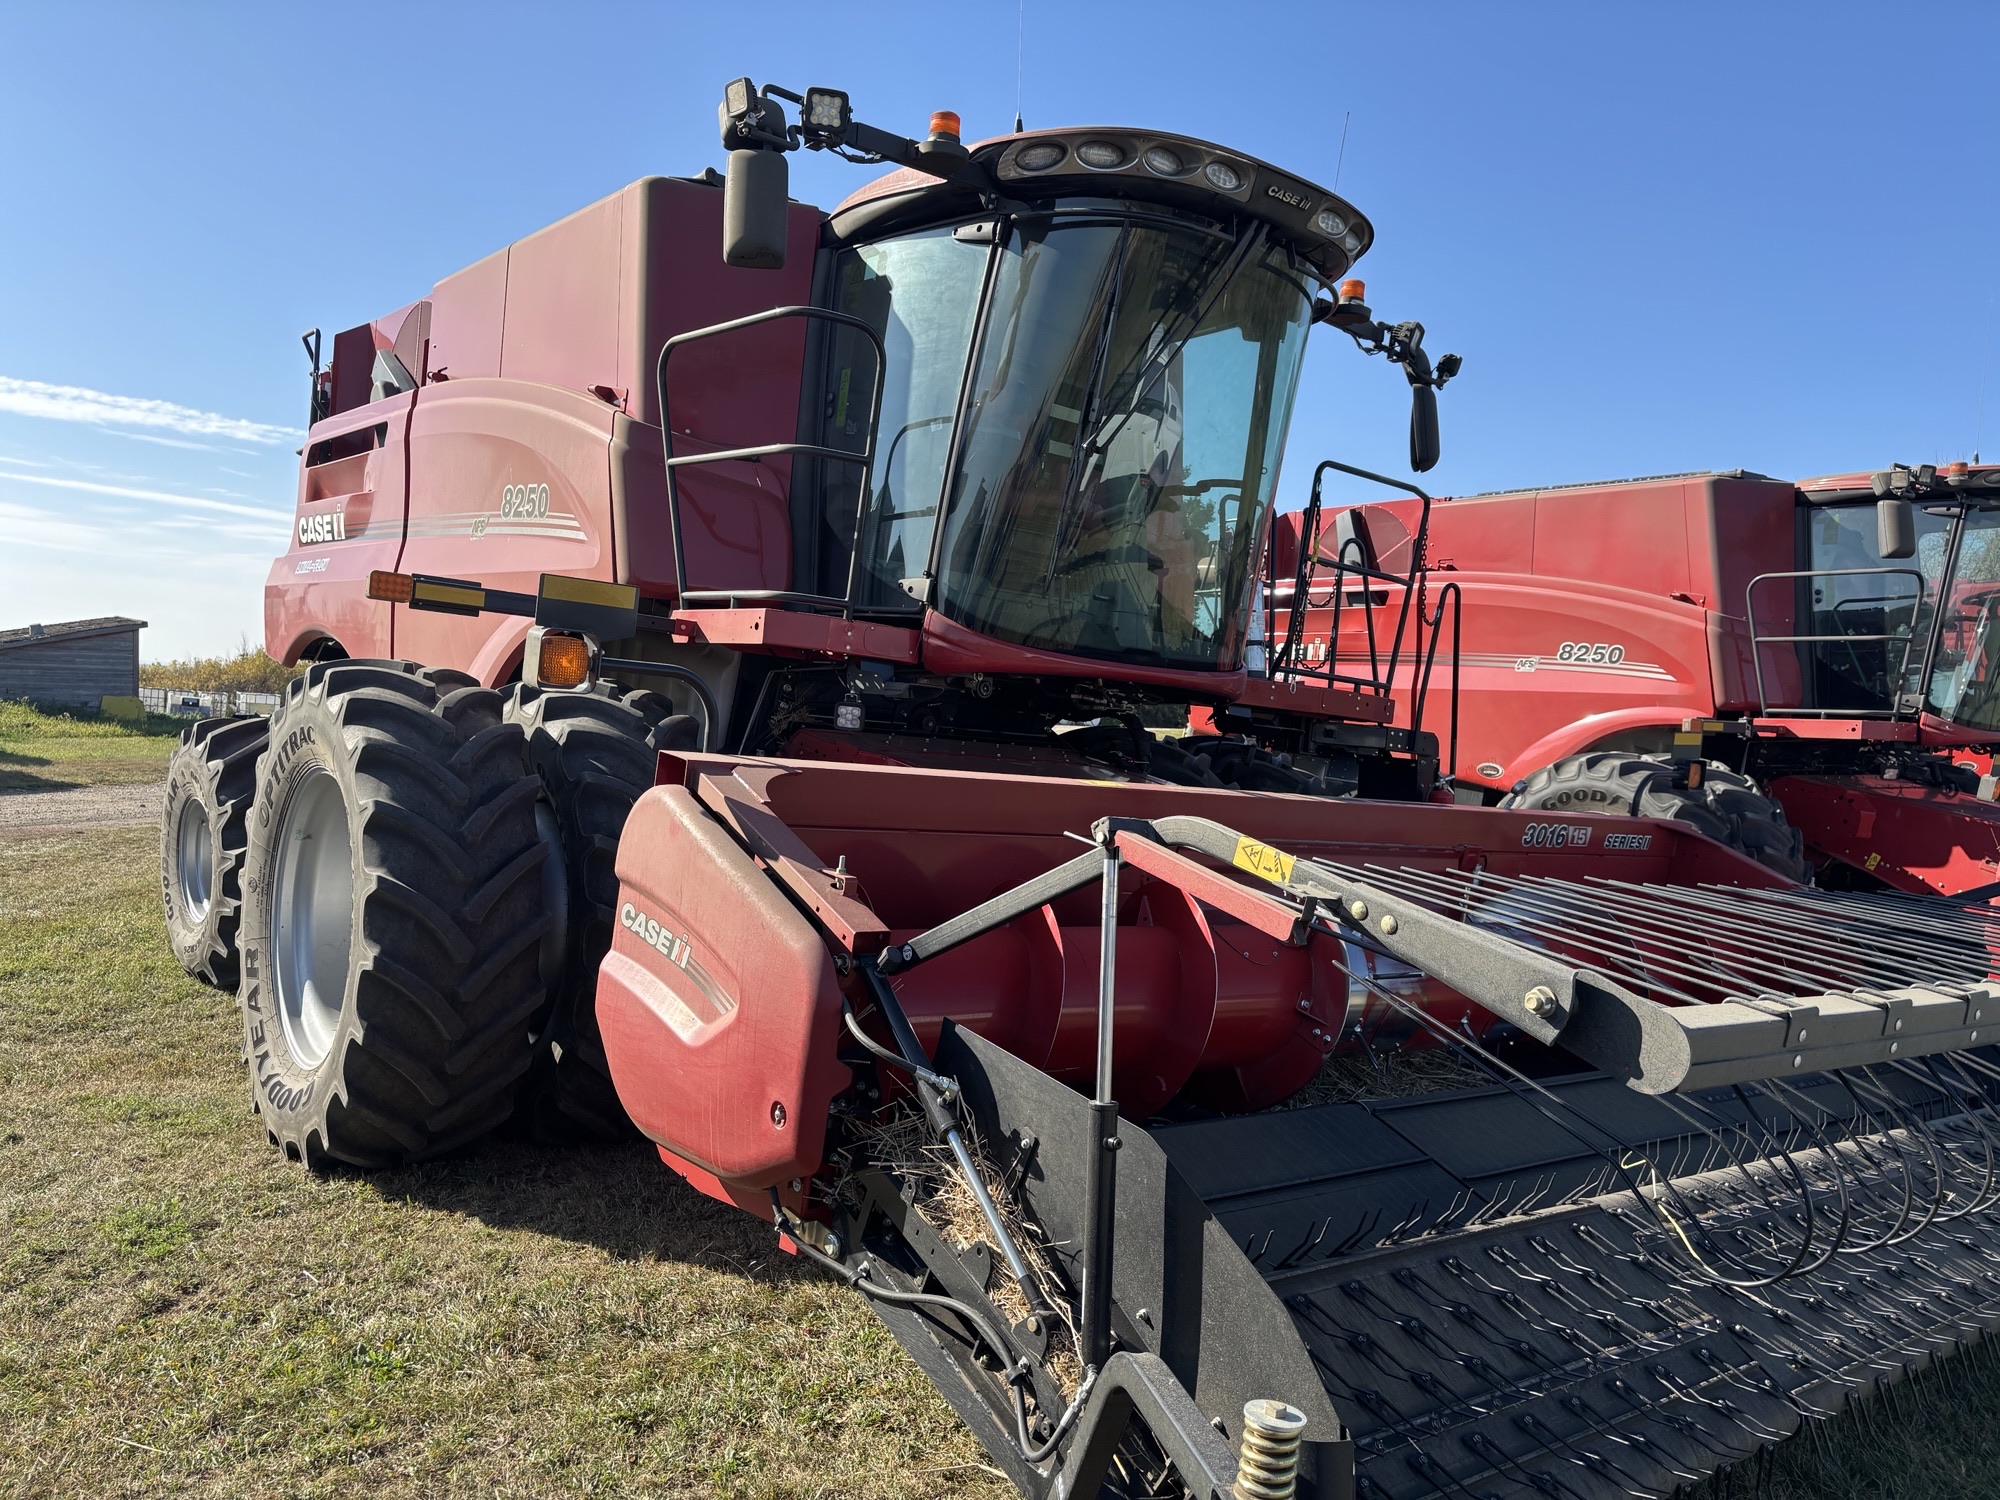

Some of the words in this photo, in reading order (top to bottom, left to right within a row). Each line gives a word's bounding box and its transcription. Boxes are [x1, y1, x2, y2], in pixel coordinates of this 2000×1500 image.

[1267, 185, 1300, 206] CASE
[500, 483, 549, 520] 8250
[298, 515, 333, 543] CASE
[1515, 658, 1536, 669] AFS
[1557, 641, 1625, 666] 8250
[259, 724, 316, 828] OPTITRAC
[1521, 822, 1569, 848] 3016
[1571, 829, 1589, 845] 15
[621, 902, 674, 956] CASE
[245, 947, 315, 1113] GOODYEAR
